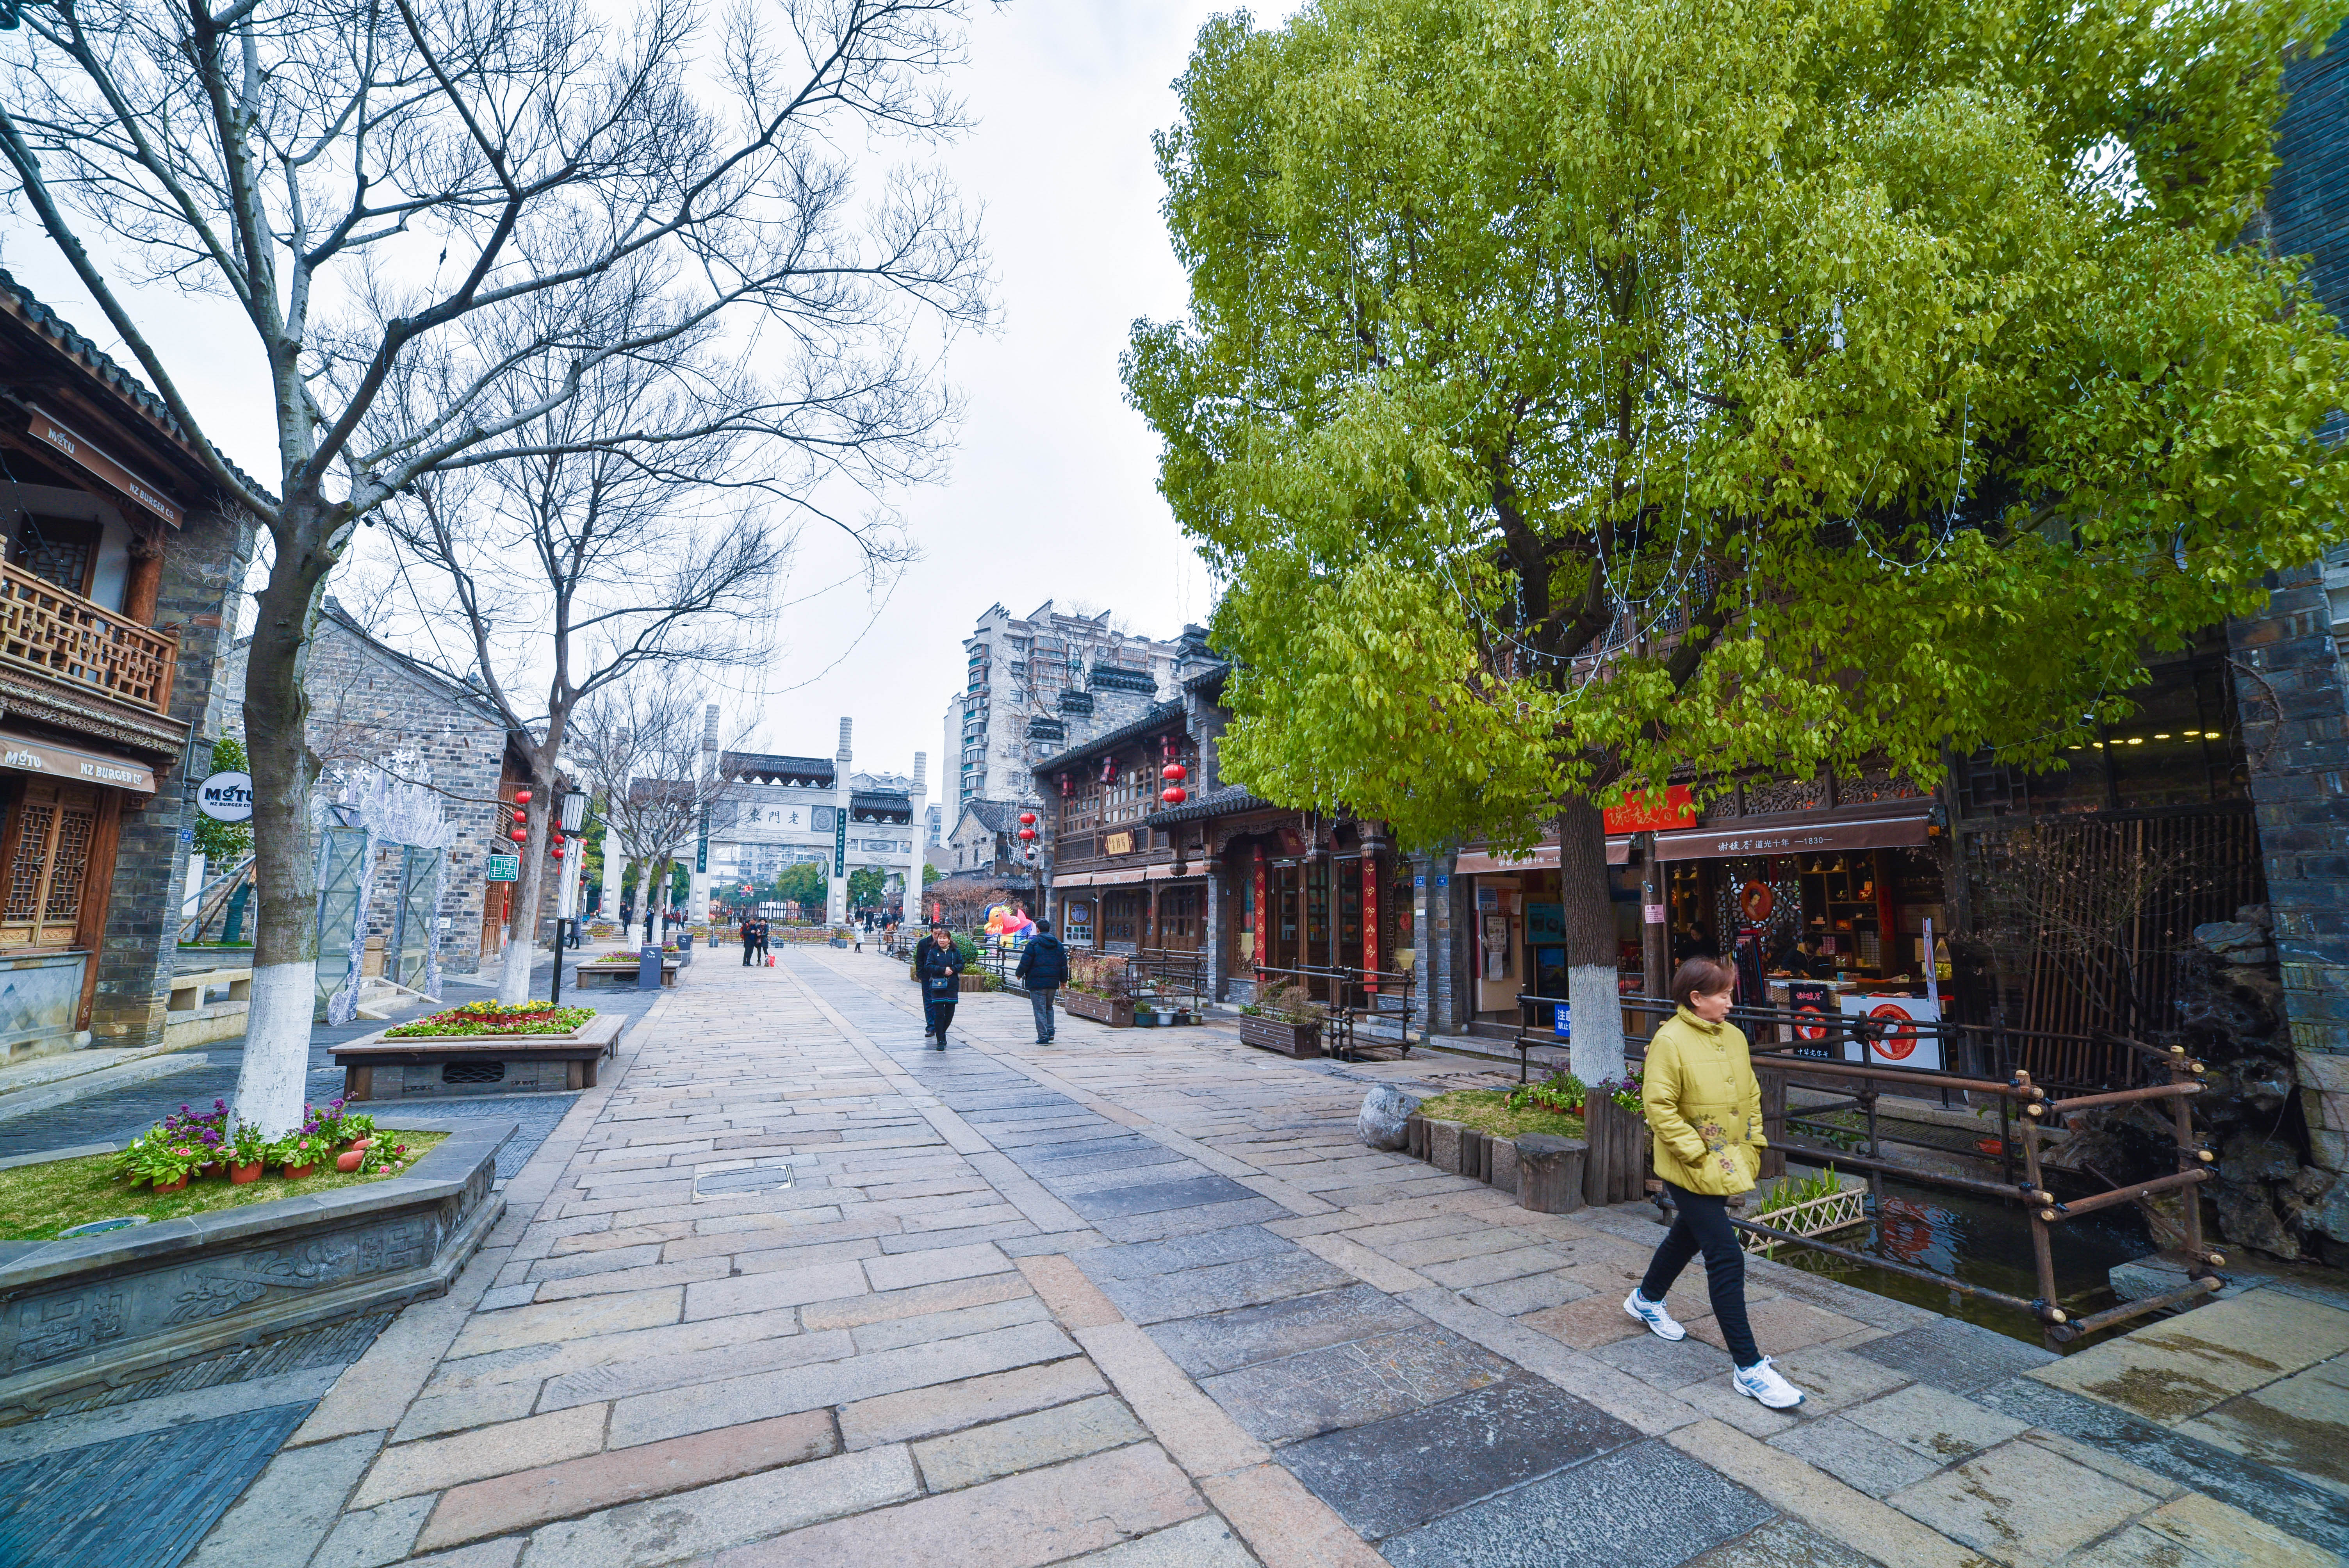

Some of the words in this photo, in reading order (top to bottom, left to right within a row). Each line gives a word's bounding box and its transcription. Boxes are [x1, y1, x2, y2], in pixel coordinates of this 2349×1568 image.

[130, 483, 139, 495] NZ
[139, 490, 164, 514] BURGER
[80, 763, 94, 775] NZ
[96, 766, 132, 783] BURGER
[1755, 838, 1790, 848] 道光十年
[1797, 1048, 1828, 1058] 中华老字号
